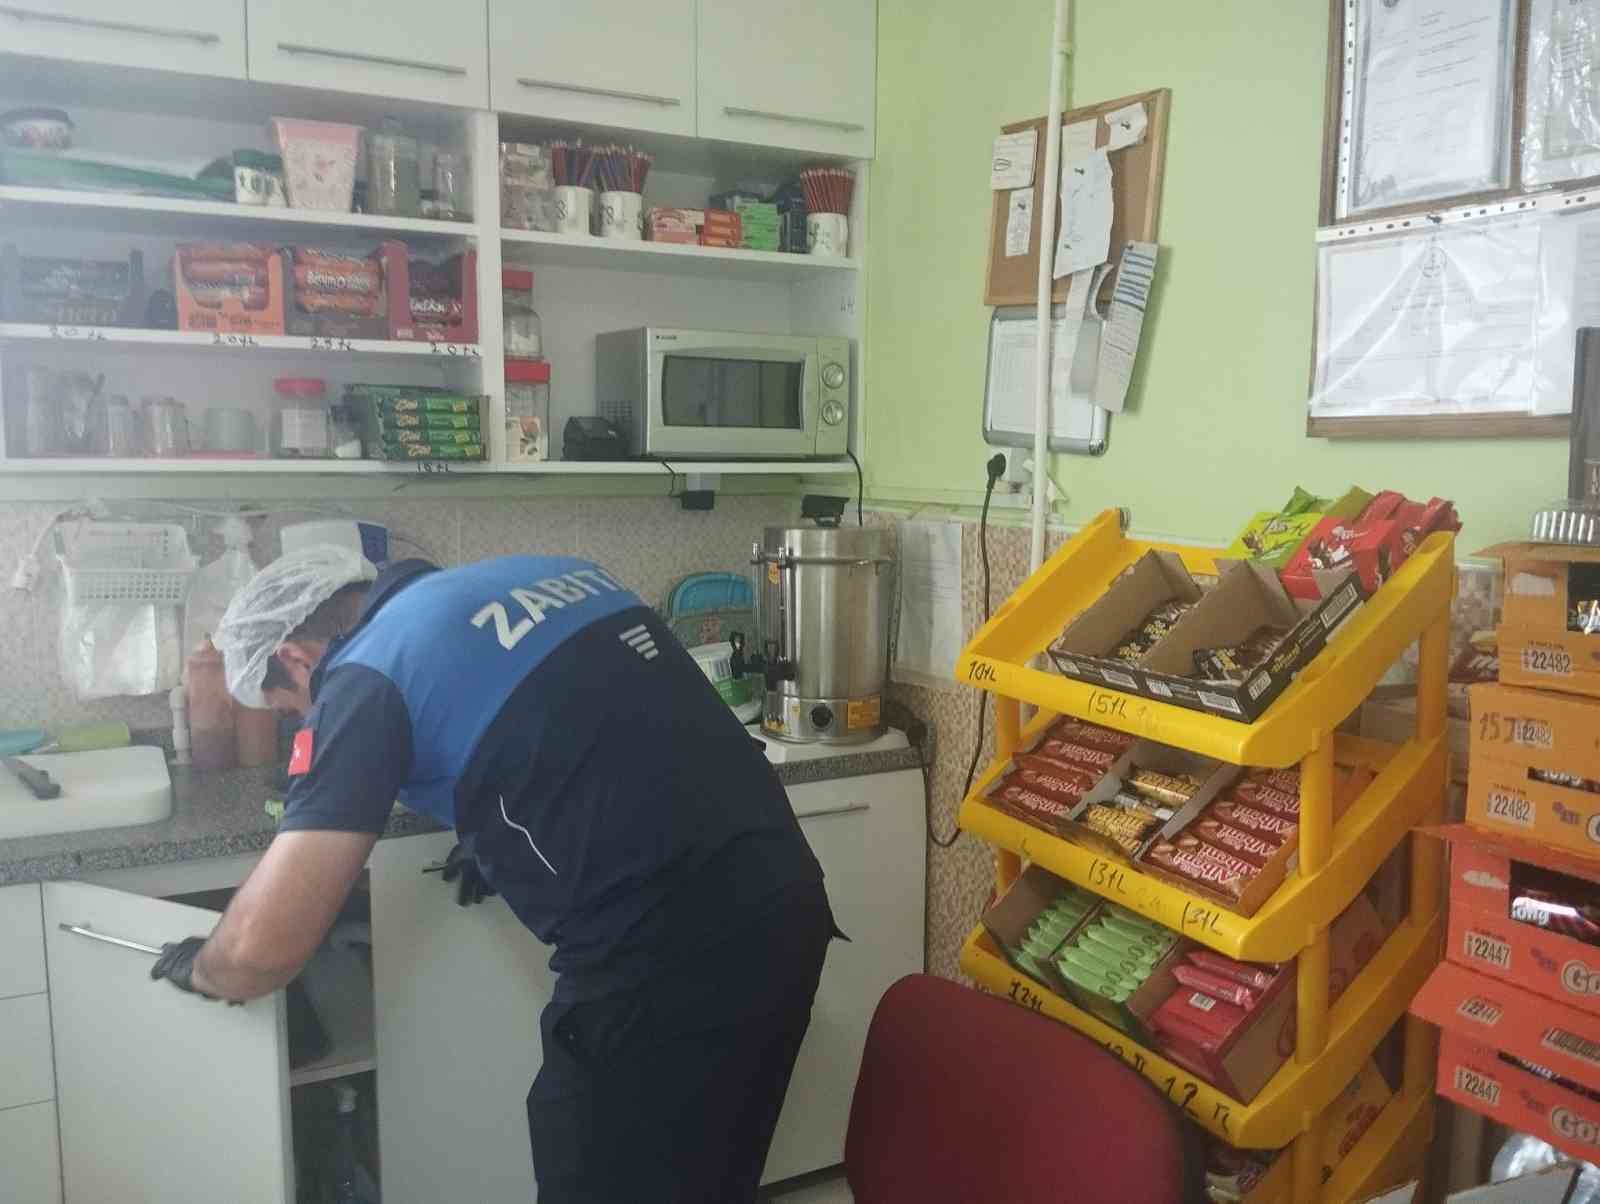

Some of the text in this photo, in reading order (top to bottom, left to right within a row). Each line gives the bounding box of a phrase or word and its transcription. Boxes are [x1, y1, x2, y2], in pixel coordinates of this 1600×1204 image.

[470, 567, 623, 651] ZABIT
[1531, 650, 1571, 674] 22482
[1494, 794, 1531, 823] 22482
[1473, 936, 1511, 967] 22447
[1464, 1072, 1501, 1105] 22447
